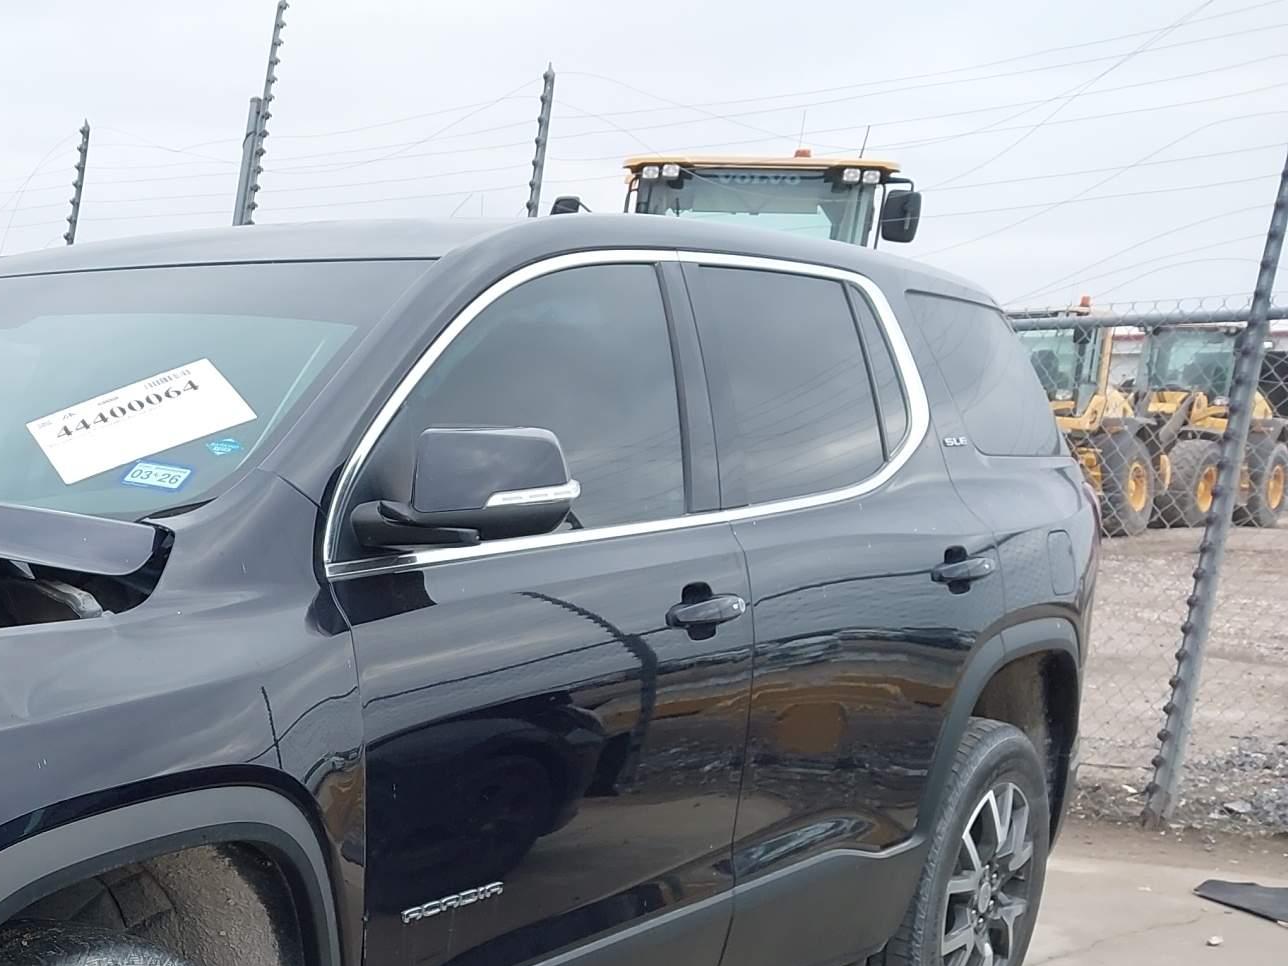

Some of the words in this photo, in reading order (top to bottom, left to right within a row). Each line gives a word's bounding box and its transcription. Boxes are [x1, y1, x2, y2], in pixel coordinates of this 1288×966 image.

[718, 172, 801, 185] VOLVO
[56, 379, 200, 440] 44400064
[942, 436, 968, 447] SLE
[130, 468, 153, 480] 03
[157, 472, 182, 485] 26
[400, 881, 504, 924] ACADIA
